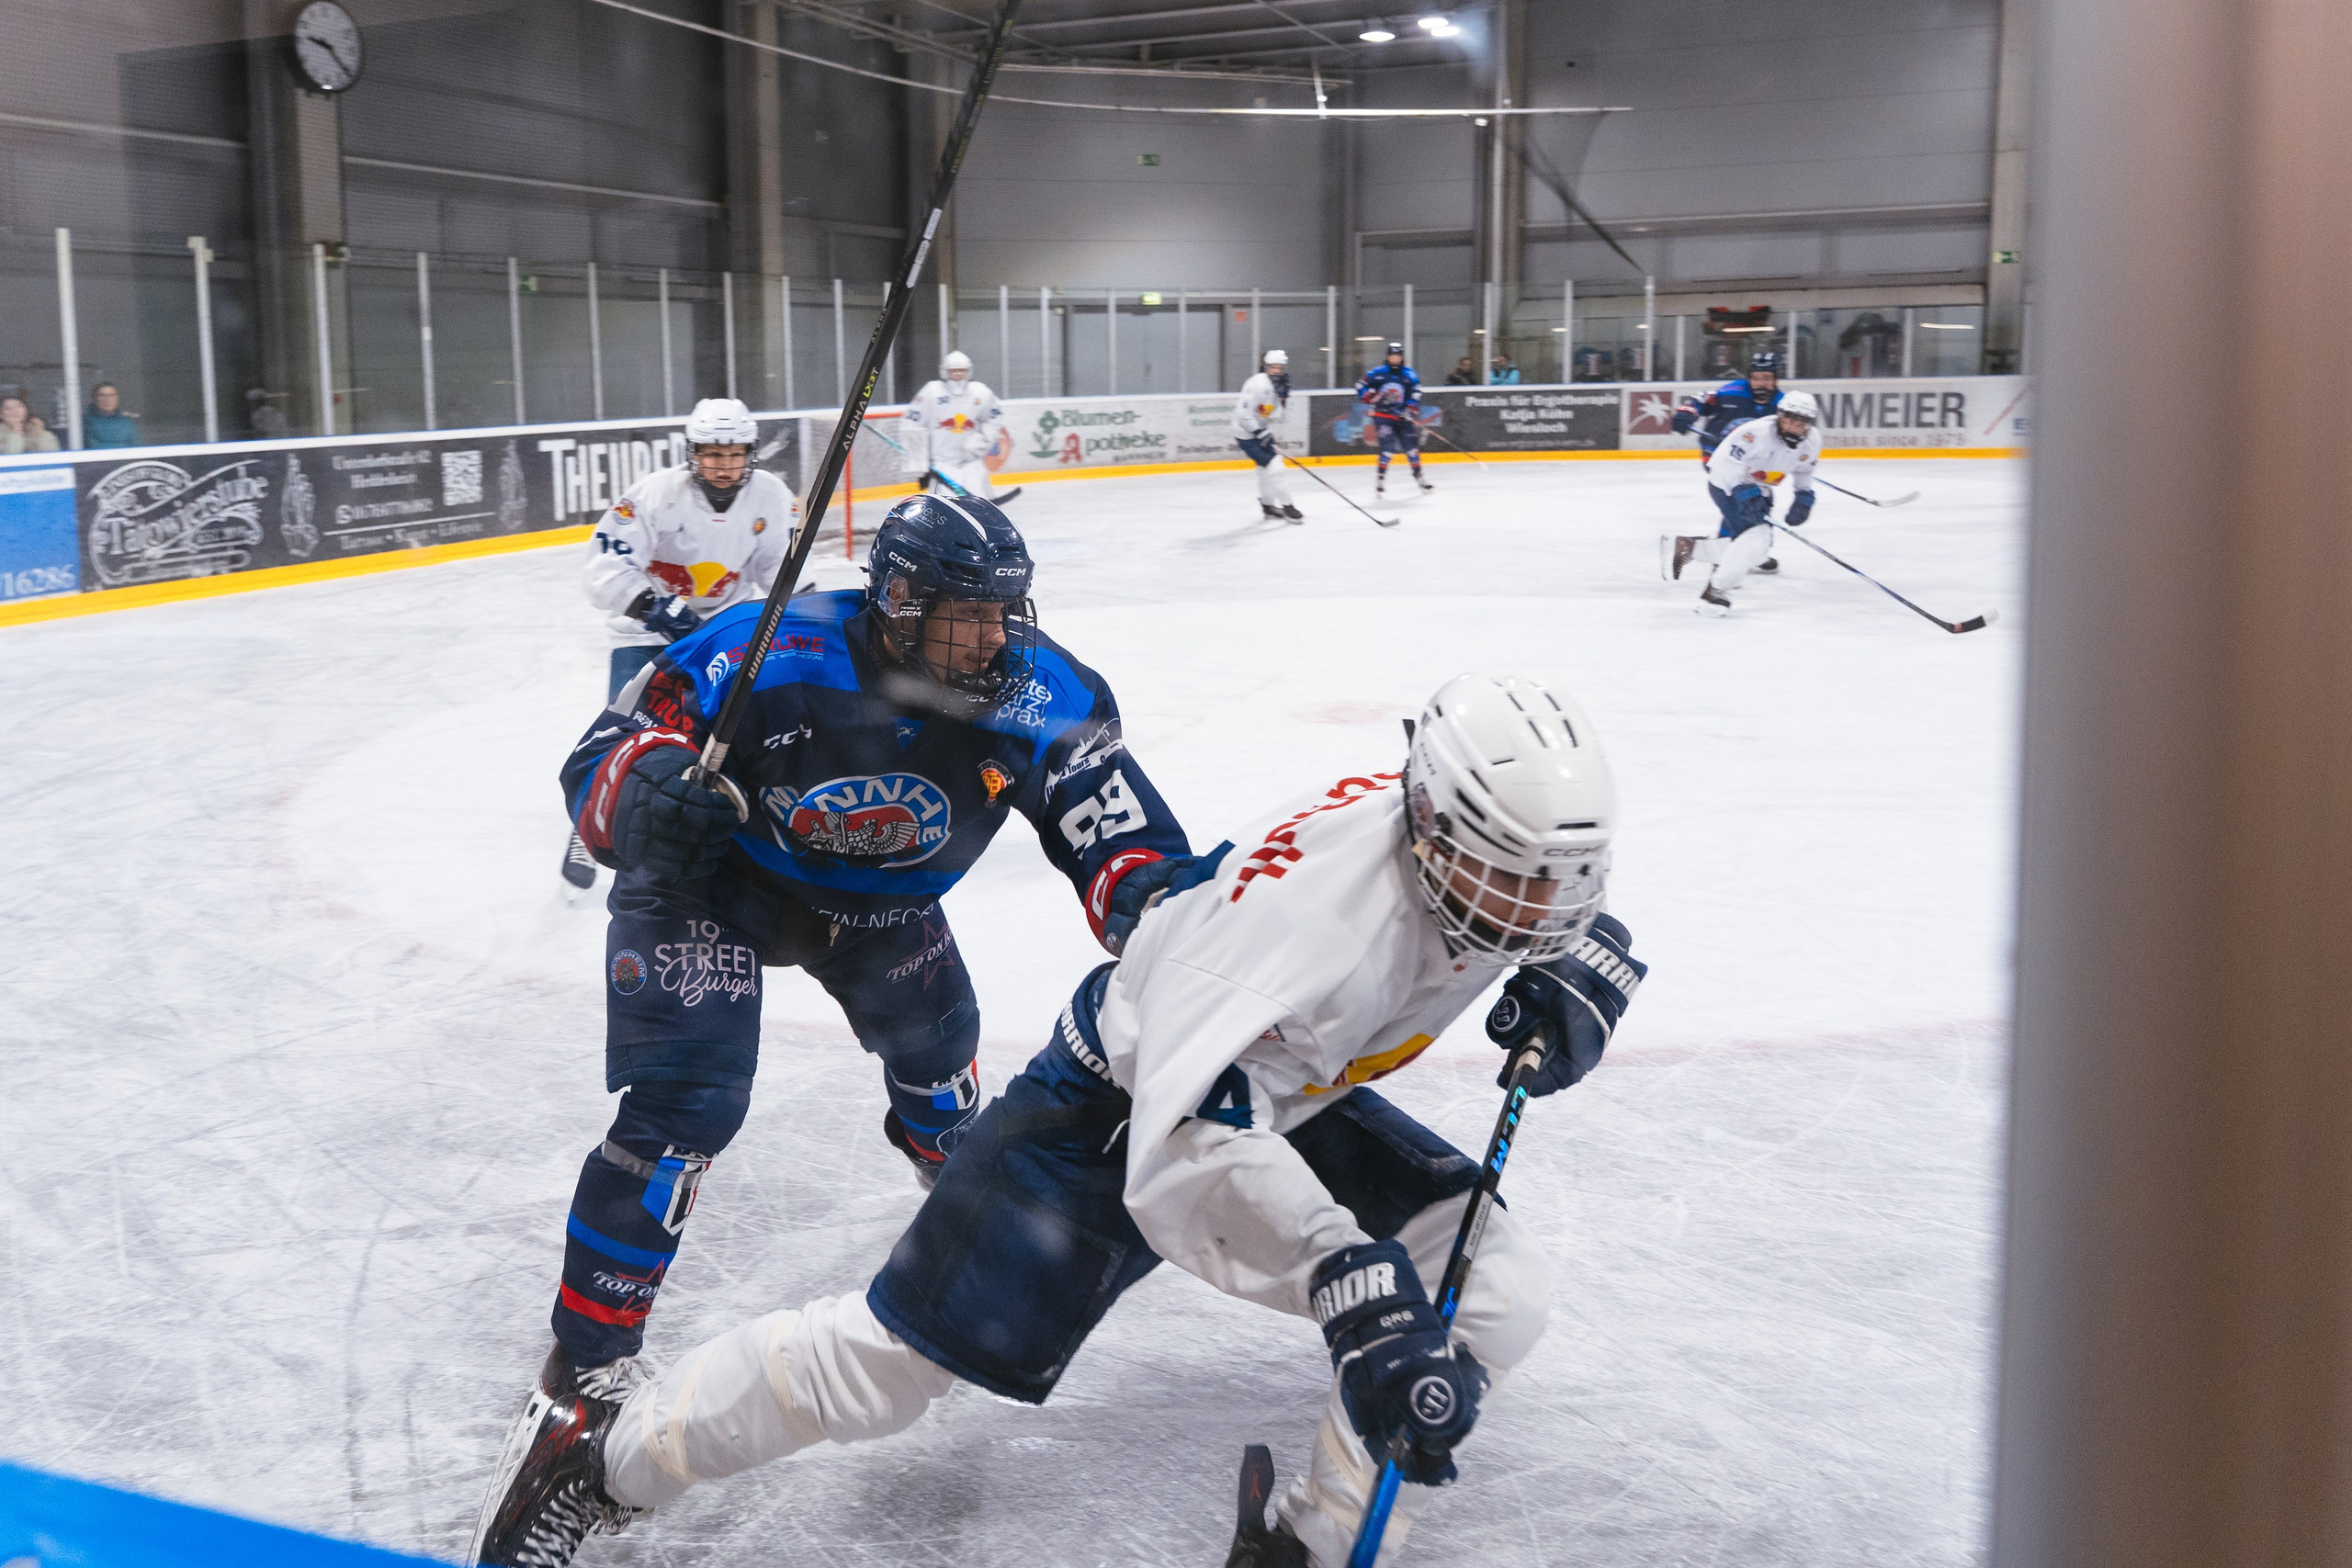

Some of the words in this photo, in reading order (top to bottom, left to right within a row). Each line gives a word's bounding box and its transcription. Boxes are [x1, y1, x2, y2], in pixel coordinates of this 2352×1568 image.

[842, 400, 867, 451] ALPHA
[1814, 391, 1966, 429] NMEIER
[888, 550, 918, 573] CCM
[994, 568, 1027, 577] CCM
[726, 634, 826, 664] SUWE
[748, 604, 784, 681] WARRIOR
[1066, 755, 1091, 775] Tours
[764, 777, 944, 844] MNNHE
[1058, 768, 1148, 862] 99
[687, 919, 720, 945] 19
[653, 942, 757, 976] STREET
[661, 953, 759, 1007] Burger
[888, 958, 924, 982] TOP
[927, 939, 944, 962] ON
[1565, 934, 1641, 1004] ARRI
[1060, 998, 1122, 1089] RRIO
[593, 1272, 638, 1294] TOP
[1313, 1261, 1398, 1329] RIOR
